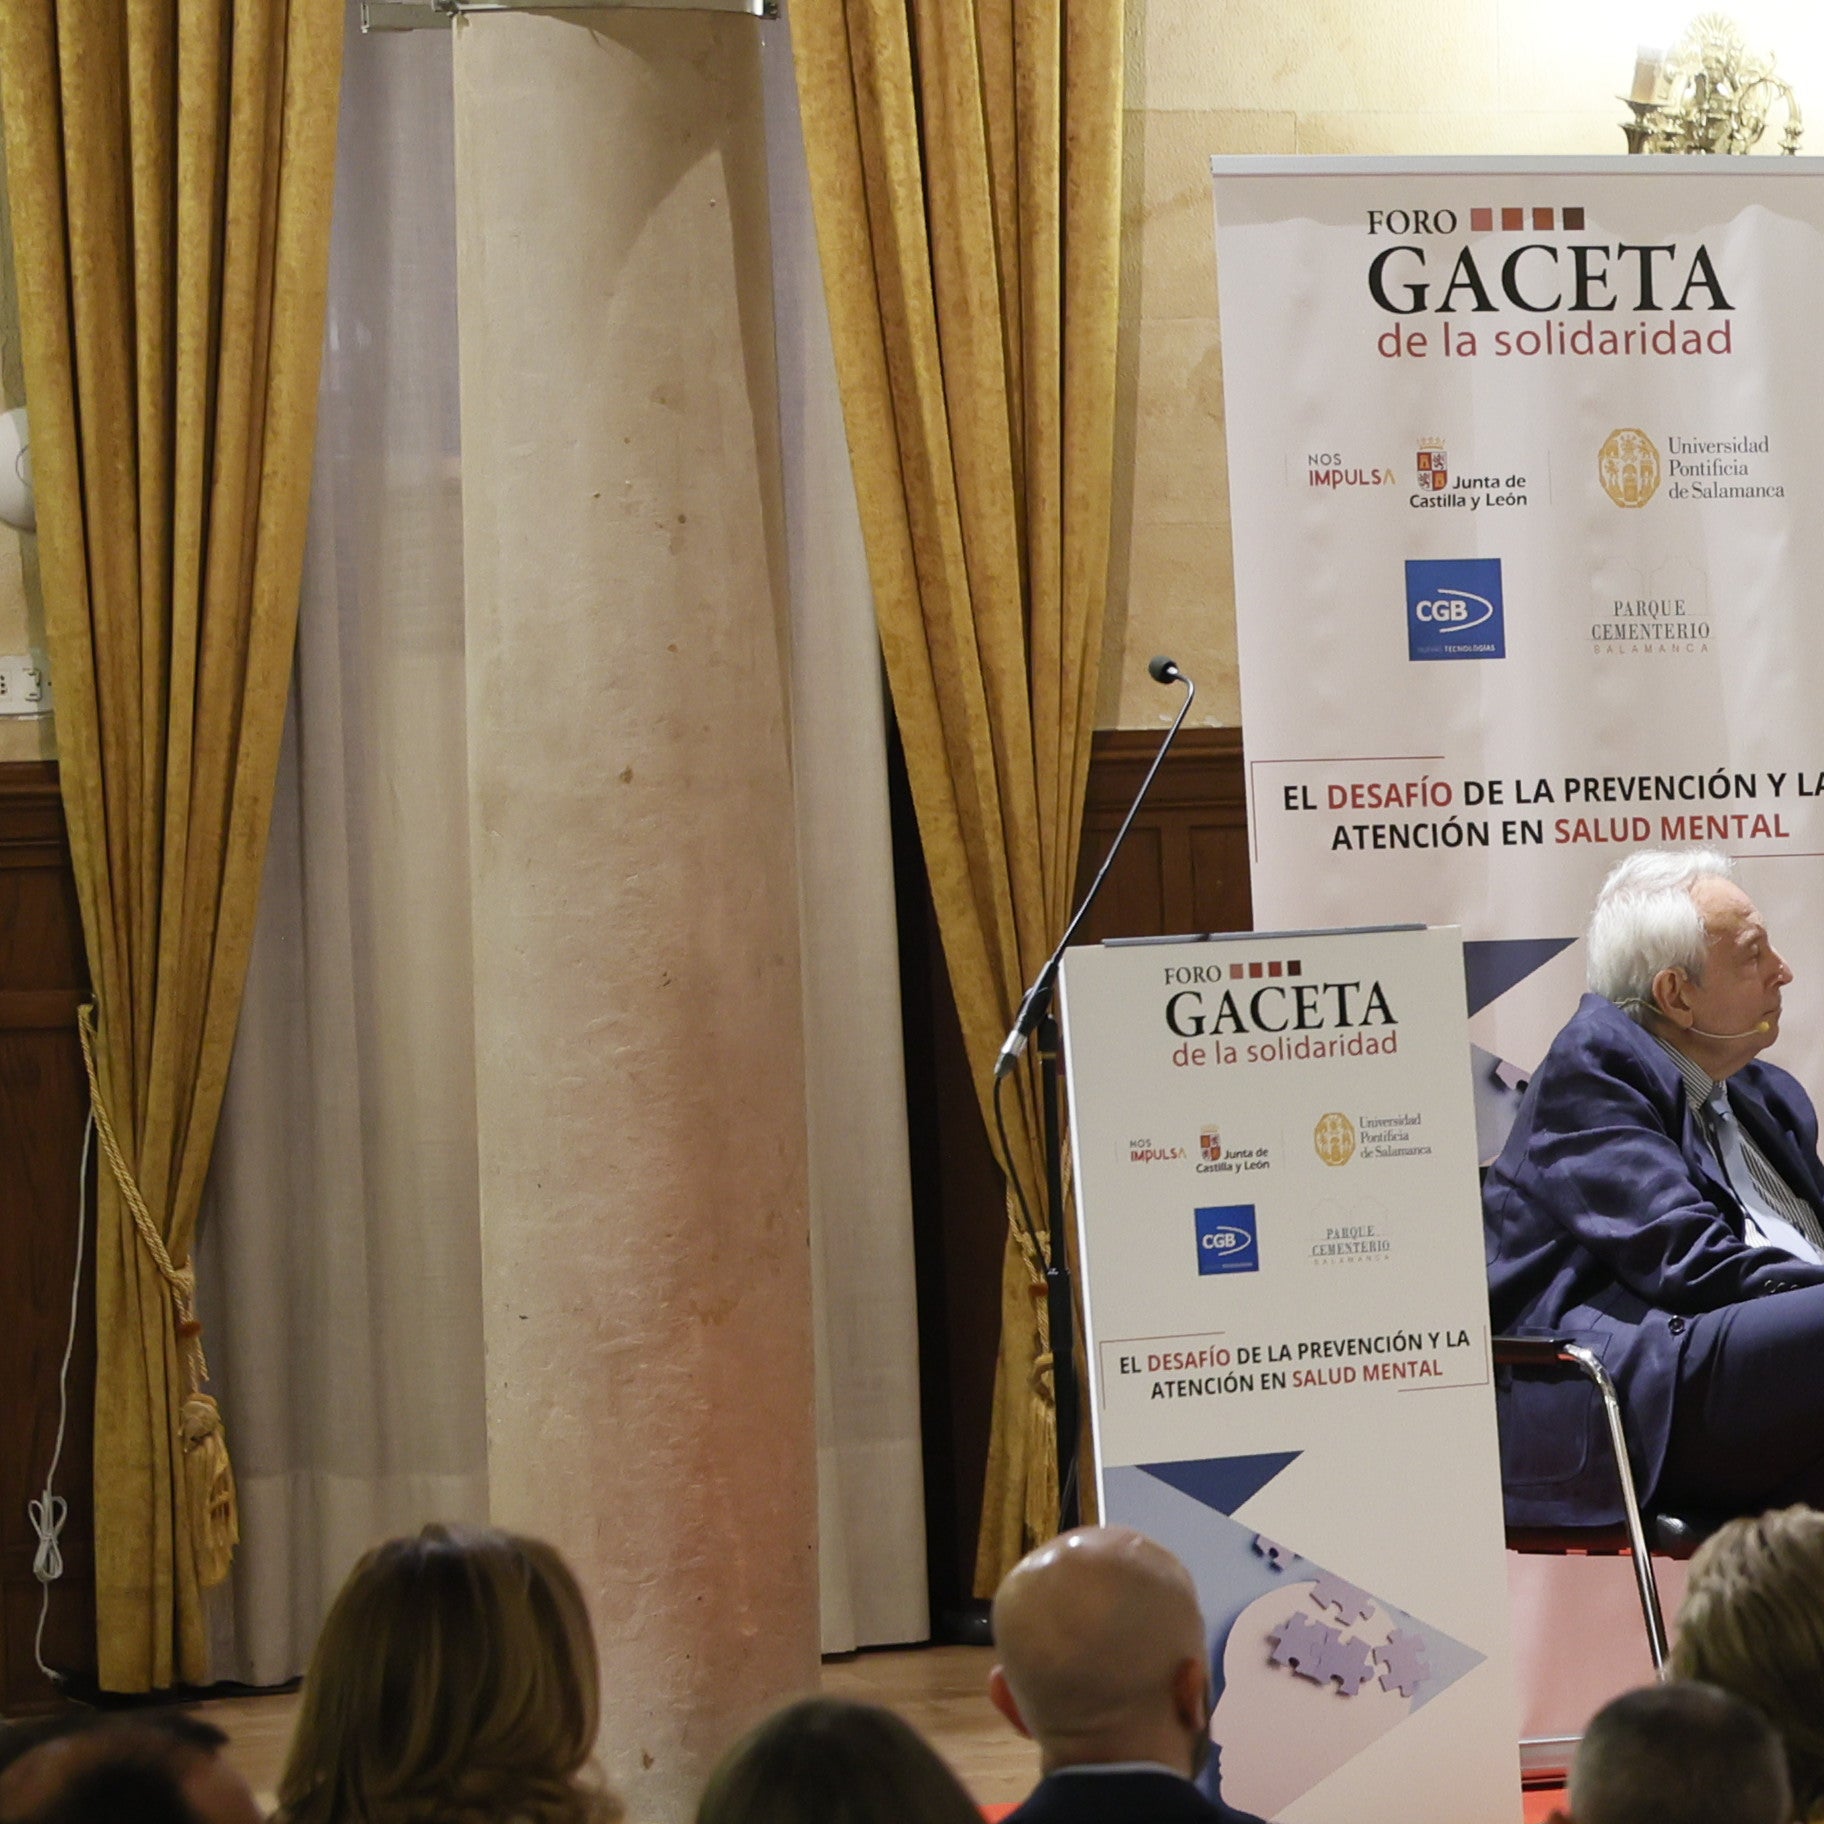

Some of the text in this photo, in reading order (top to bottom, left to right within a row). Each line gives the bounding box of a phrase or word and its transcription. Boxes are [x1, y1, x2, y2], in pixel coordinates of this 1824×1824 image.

[1367, 209, 1457, 234] FORO
[1369, 243, 1735, 314] GACETA
[1378, 320, 1731, 357] de la solidaridad
[1668, 435, 1768, 454] Universidad
[1309, 453, 1341, 466] NOS
[1669, 459, 1748, 476] Pontificia
[1453, 475, 1526, 489] Junta de
[1669, 481, 1784, 499] de Salamanca
[1410, 493, 1527, 511] Castilla y León
[1417, 600, 1467, 621] CGB
[1614, 600, 1685, 620] PARQUE
[1592, 623, 1709, 640] CEMENTERIO
[1594, 643, 1707, 655] SALAMANCA
[1284, 785, 1317, 810] EL
[1328, 779, 1452, 809] DESAFÍO
[1464, 781, 1503, 805] DE
[1516, 779, 1555, 804] LA
[1565, 768, 1756, 803] PREVENCIÓN
[1767, 773, 1786, 797] Y
[1332, 814, 1789, 850] ATENCIÓN EN SALUD MENTAL
[1165, 966, 1221, 985] FORO
[1166, 981, 1398, 1037] GACETA
[1173, 1030, 1397, 1067] de la solidaridad
[1359, 1113, 1421, 1128] Universidad
[1361, 1129, 1409, 1144] Pontificia
[1224, 1150, 1253, 1160] Junta
[1375, 1145, 1432, 1157] Salamanca
[1196, 1162, 1233, 1173] Castilla
[1244, 1157, 1269, 1170] León
[1203, 1233, 1236, 1249] CGB
[1327, 1226, 1374, 1240] PARQUE
[1312, 1240, 1389, 1256] CEMENTERIO
[1120, 1330, 1470, 1374] EL DESAFÍO DE LA PREVENCIÓN Y LA
[1151, 1360, 1443, 1399] ATENCIÓN EN SALUD MENTAL
